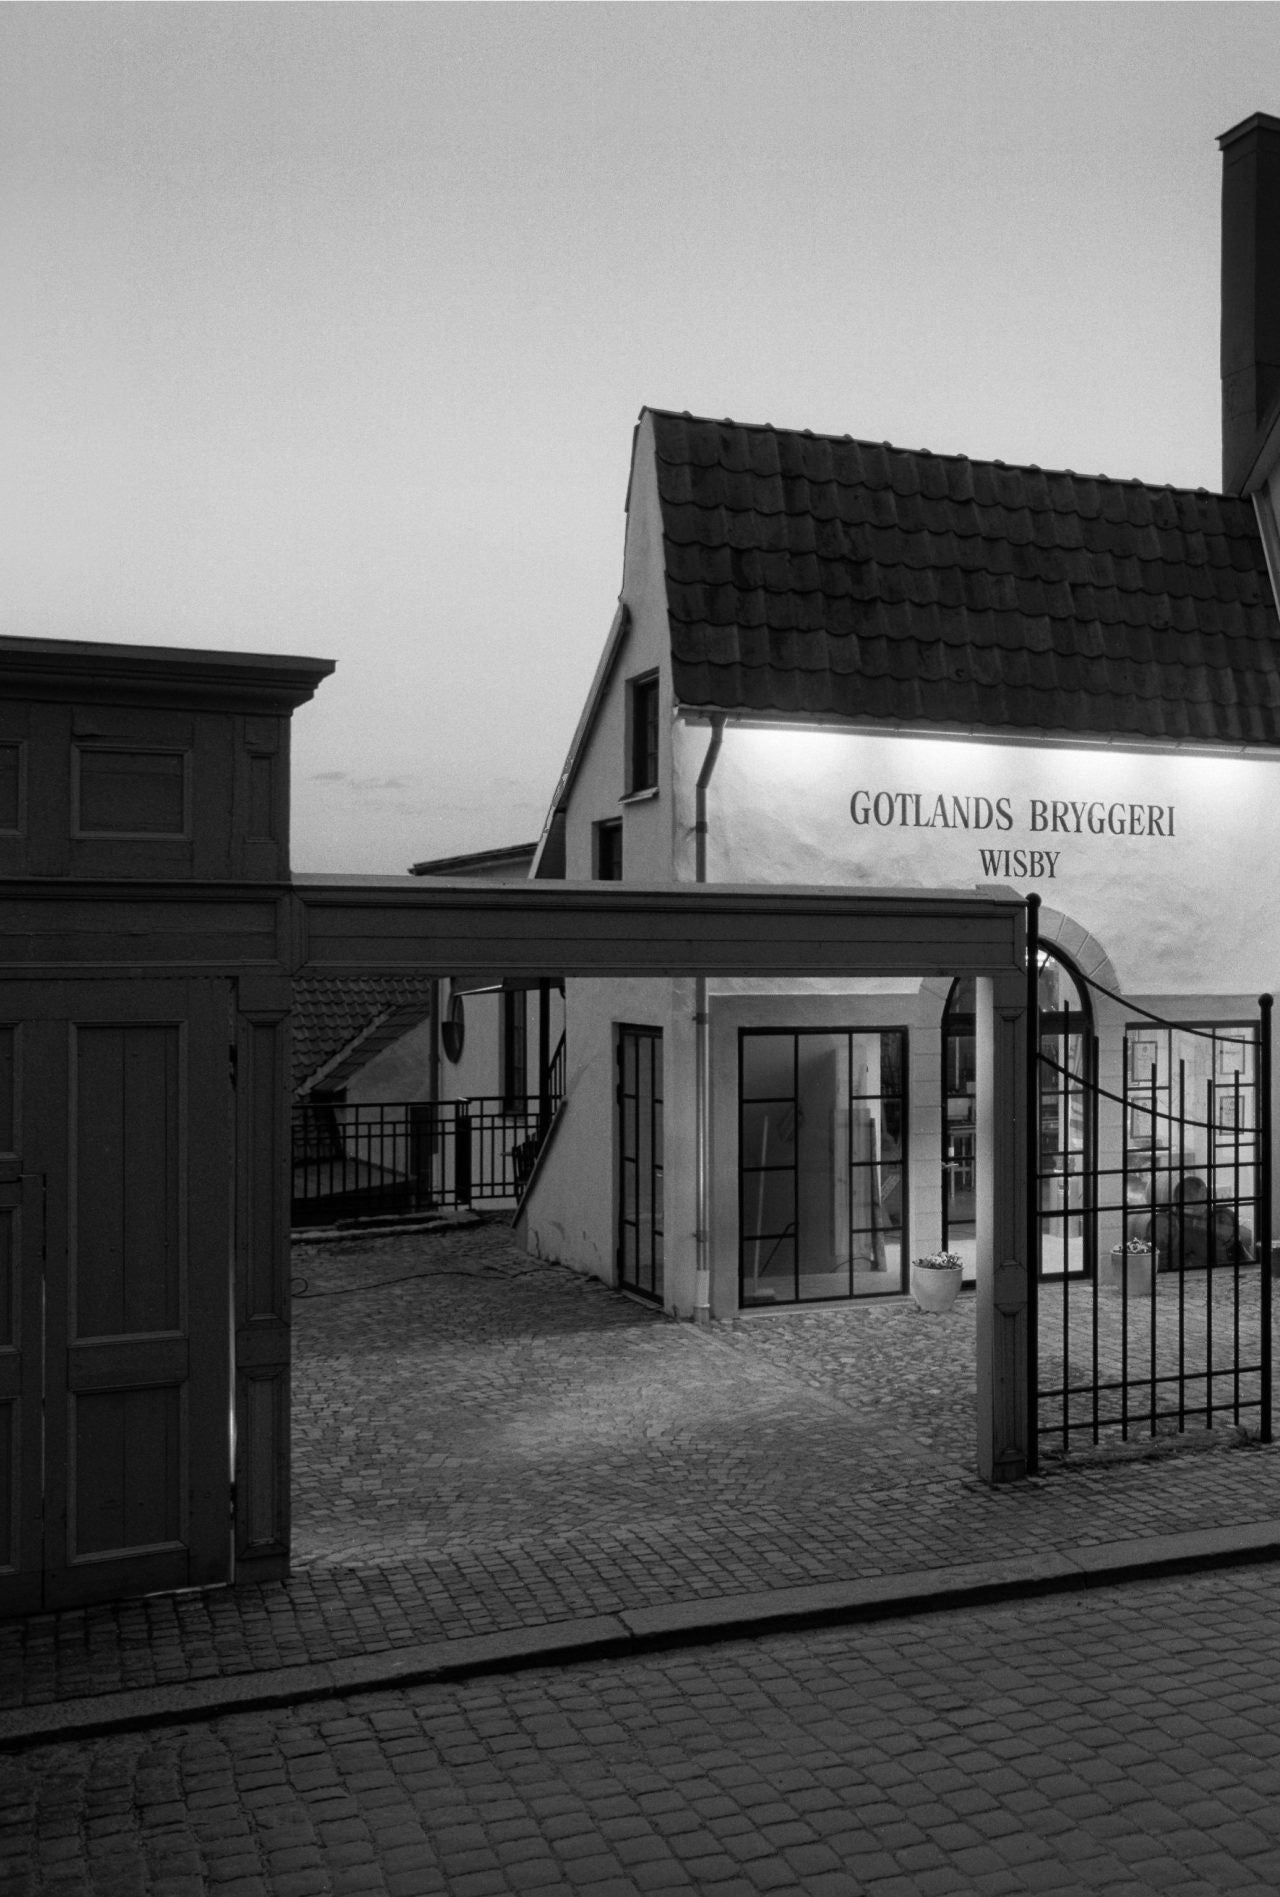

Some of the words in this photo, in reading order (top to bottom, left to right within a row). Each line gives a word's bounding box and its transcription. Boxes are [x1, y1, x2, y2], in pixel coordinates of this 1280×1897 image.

[850, 790, 1014, 831] GOTLANDS
[1029, 799, 1175, 836] BRYGGERI
[978, 848, 1061, 878] WISBY
